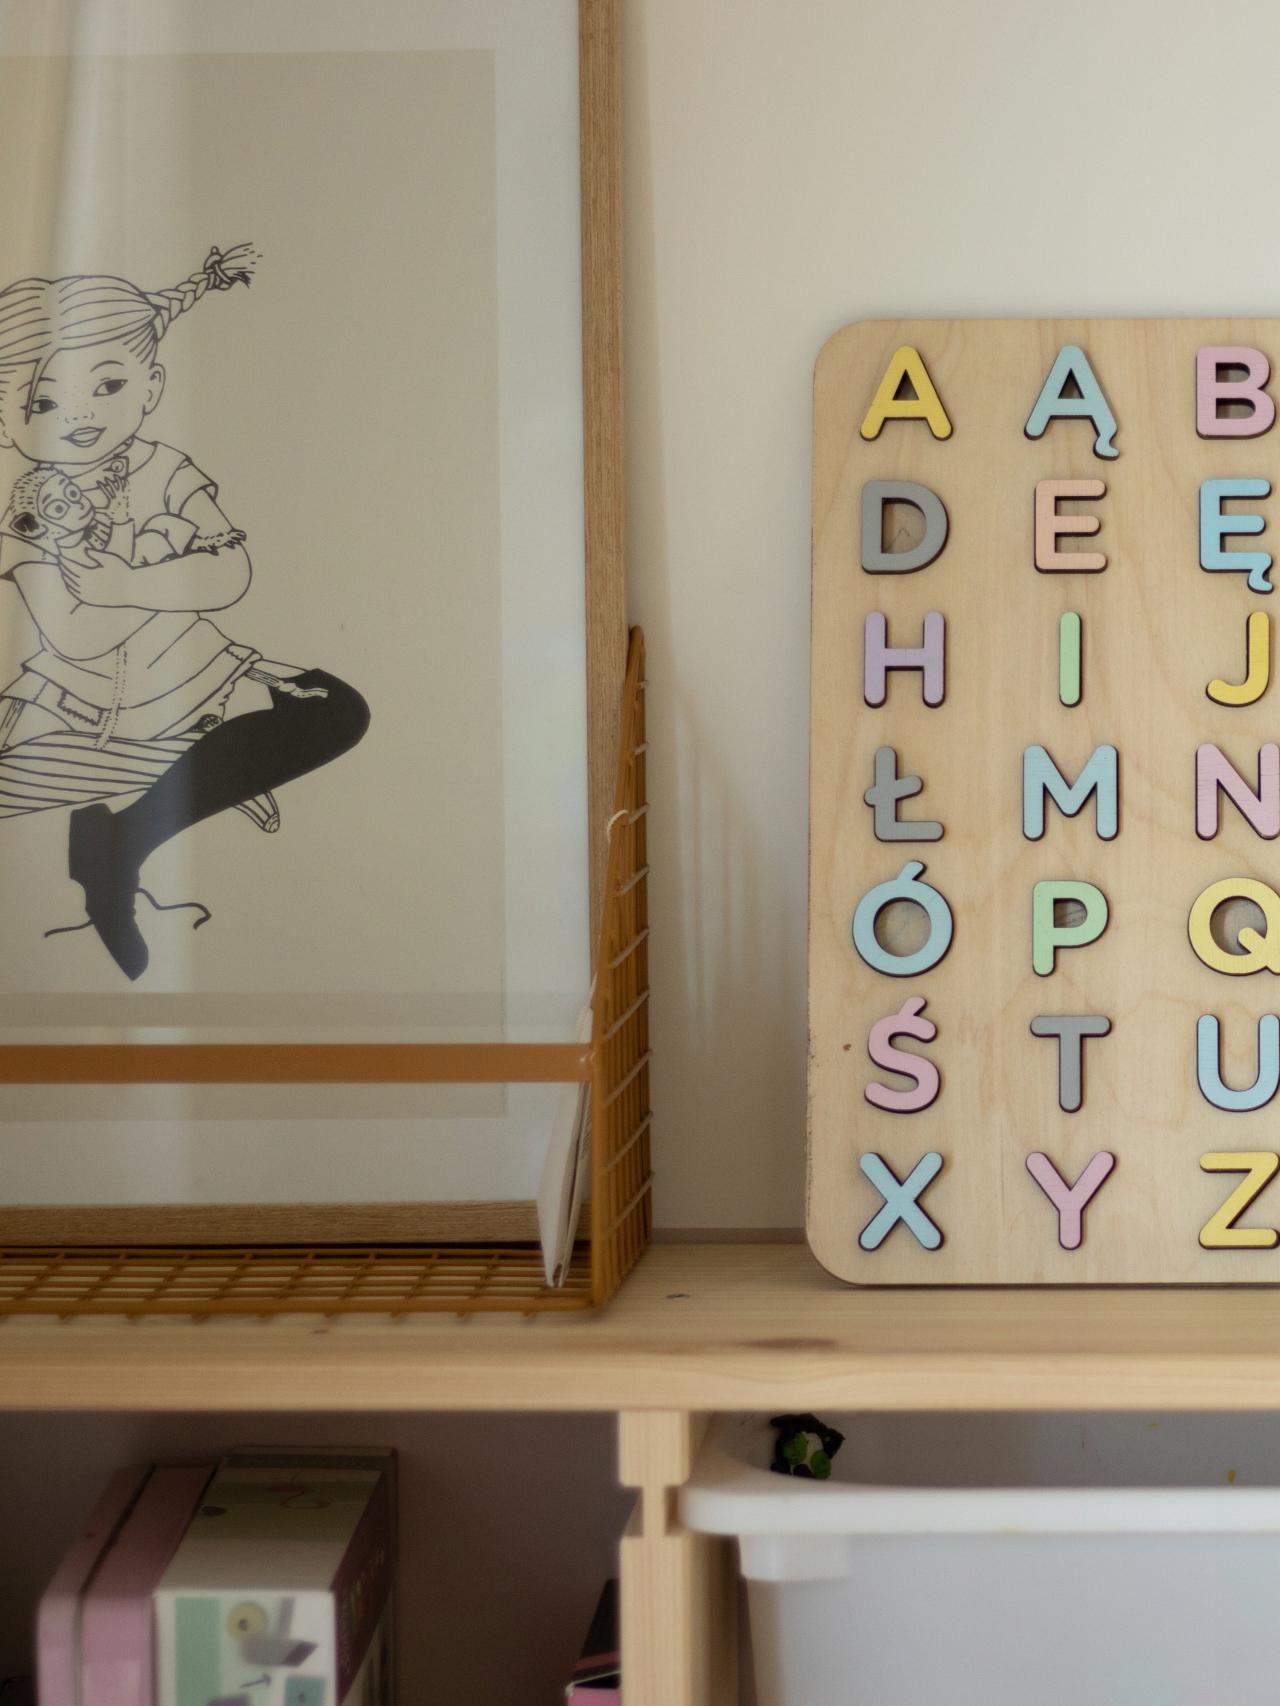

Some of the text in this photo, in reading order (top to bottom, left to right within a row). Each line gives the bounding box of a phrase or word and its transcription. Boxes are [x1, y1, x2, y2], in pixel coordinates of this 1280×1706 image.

[859, 345, 953, 441] A
[1024, 345, 1120, 460] Ą
[1196, 345, 1277, 440] B
[860, 480, 951, 576] D
[1033, 480, 1108, 574] E
[1198, 477, 1276, 596] Ę
[862, 611, 948, 709] H
[1059, 612, 1085, 709] I
[1205, 611, 1275, 709] J
[863, 747, 947, 844] Ł
[1021, 744, 1122, 842] M
[850, 860, 956, 978] Ó
[1032, 881, 1112, 978] P
[863, 996, 943, 1115] Ś
[1029, 1015, 1114, 1114] T
[857, 1151, 947, 1253] X
[1024, 1151, 1118, 1251] Y
